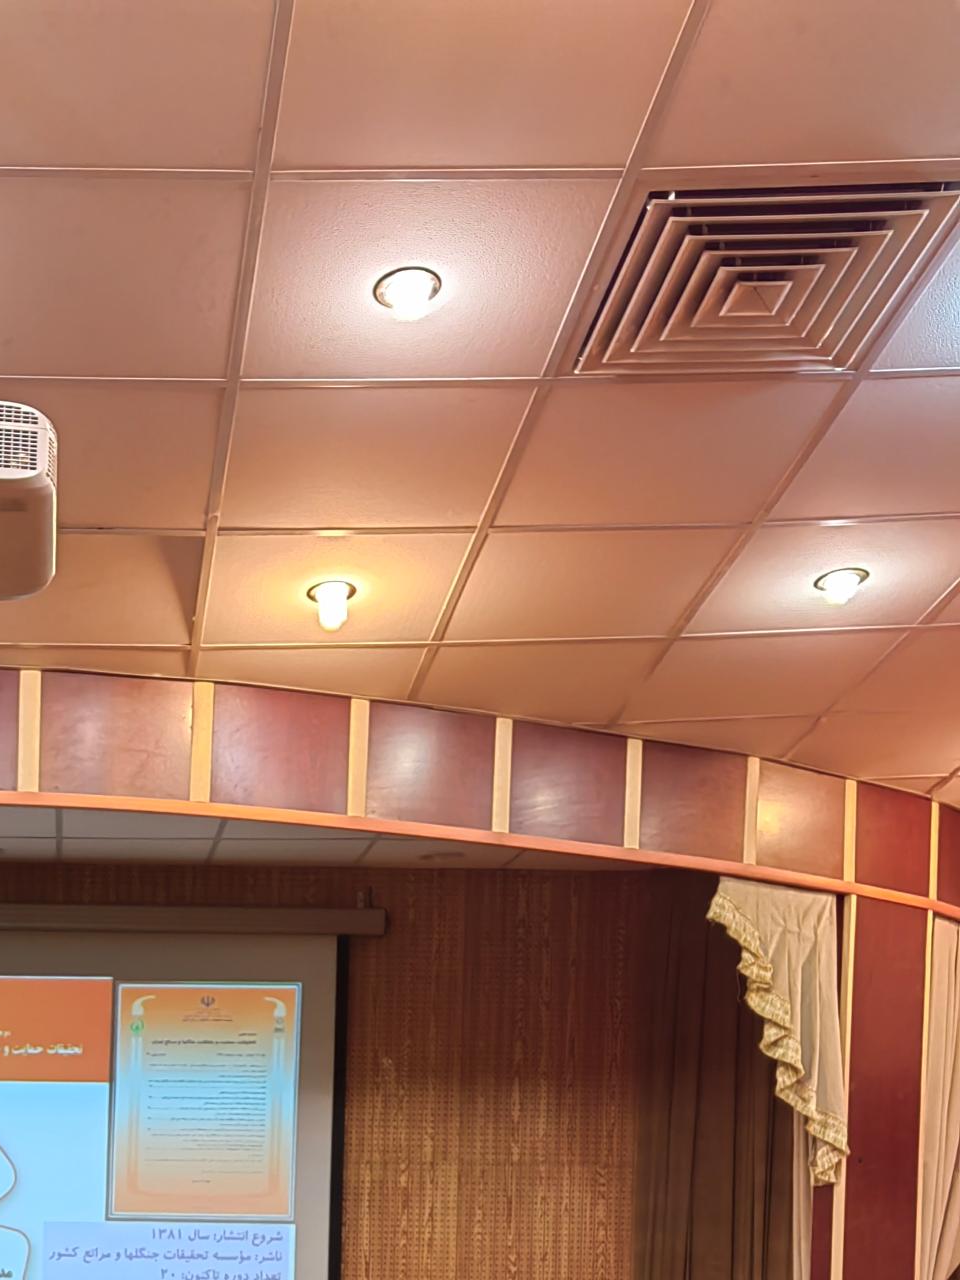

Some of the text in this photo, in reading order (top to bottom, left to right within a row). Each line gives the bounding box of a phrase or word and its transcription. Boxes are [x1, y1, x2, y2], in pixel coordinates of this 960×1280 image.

[152, 1228, 182, 1240] ۱۳۸۱
[188, 1230, 210, 1242] سال
[252, 1230, 283, 1247] شروع
[49, 1246, 79, 1261] کشور
[83, 1247, 111, 1264] مراتع
[124, 1247, 159, 1262] جنگلها
[164, 1249, 209, 1263] تحقیقات
[255, 1250, 283, 1264] ناشر:
